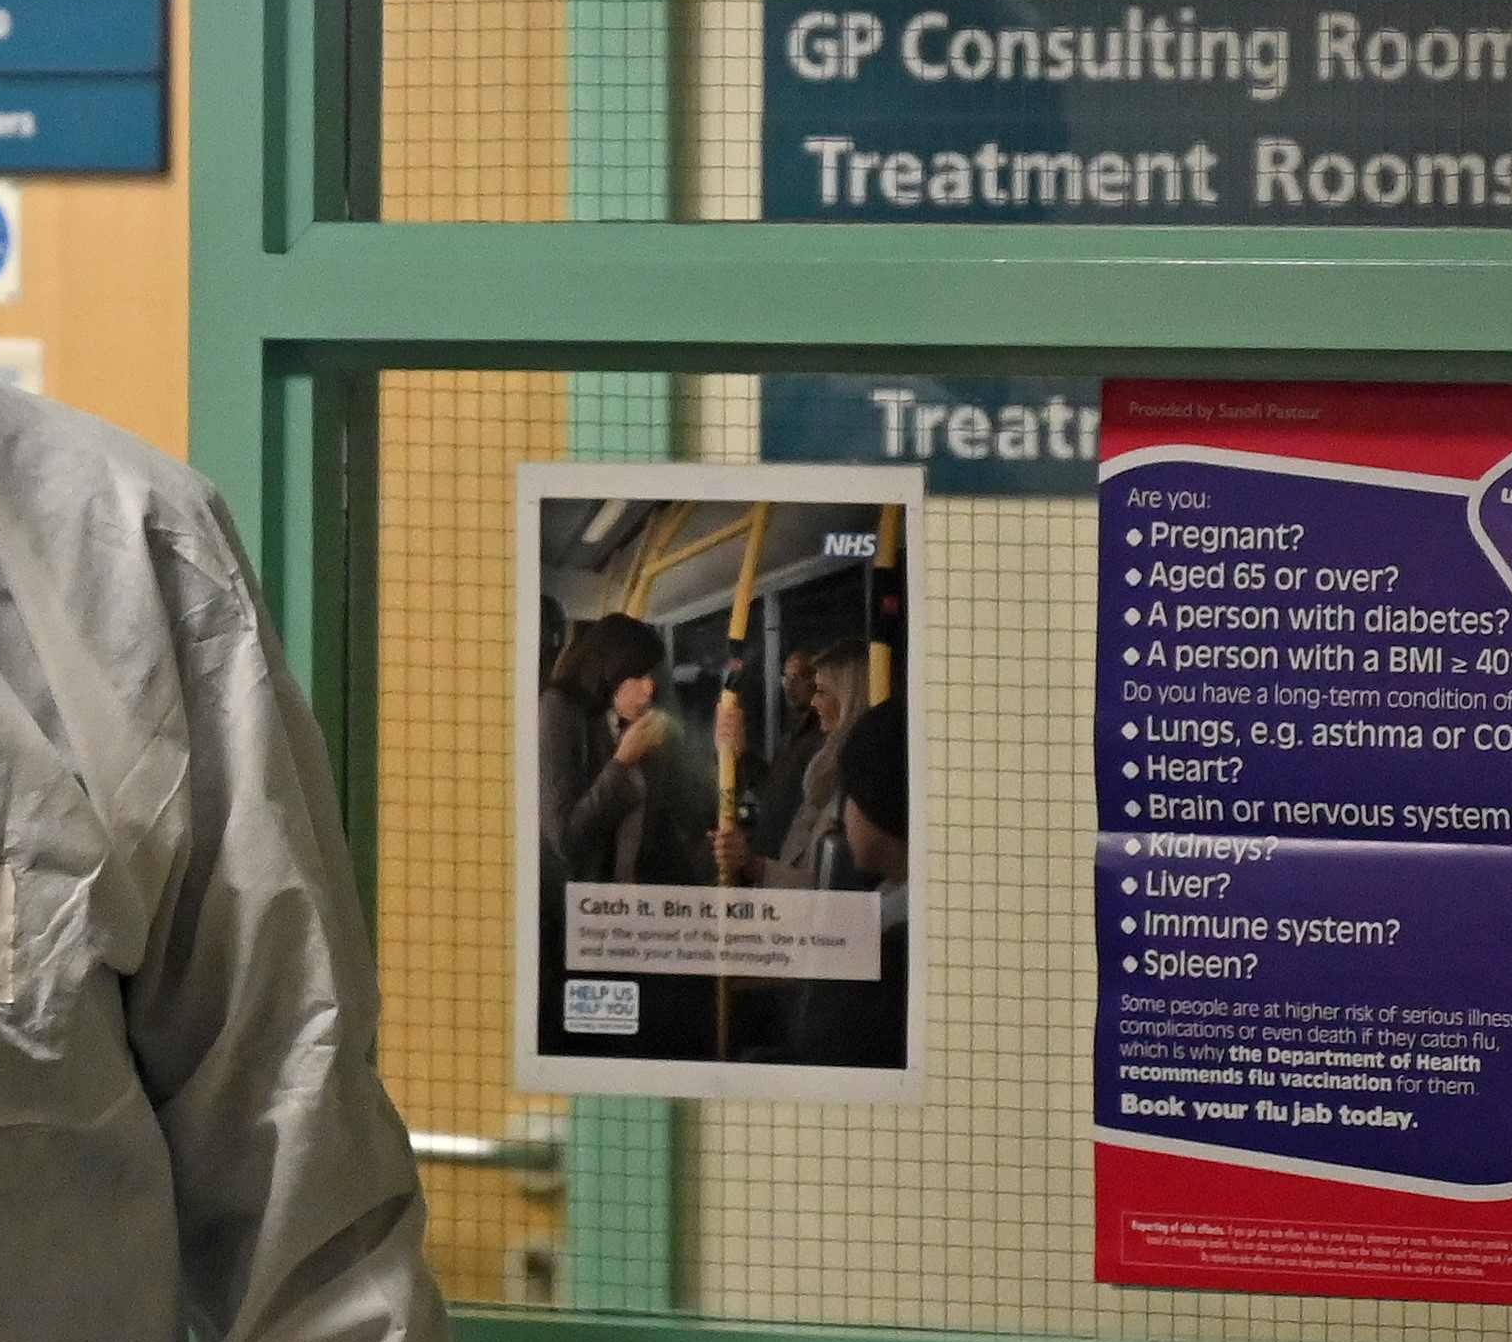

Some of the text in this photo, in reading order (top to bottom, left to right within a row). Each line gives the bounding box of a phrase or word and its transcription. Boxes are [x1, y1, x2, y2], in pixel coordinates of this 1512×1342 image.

[786, 12, 885, 82] GP
[902, 8, 1289, 98] Consulting
[805, 136, 1218, 208] Treatment
[1129, 402, 1192, 417] Provided
[1197, 403, 1214, 420] by
[1128, 488, 1212, 511] Are you:
[825, 534, 875, 556] NHS
[1150, 522, 1304, 552] Pregnant?
[1149, 561, 1399, 593] Aged 65 or over?
[1147, 601, 1509, 635] A person with diabetes?
[1146, 641, 1166, 667] A
[1175, 644, 1277, 671] person
[1287, 643, 1354, 671] with
[1363, 653, 1379, 672] a
[1390, 648, 1442, 673] BMI
[1124, 681, 1152, 702] Do
[1157, 687, 1196, 709] you
[1202, 683, 1251, 704] have
[1257, 689, 1268, 704] a
[1274, 683, 1378, 709] long-term
[1387, 687, 1487, 710] condition
[1146, 715, 1241, 748] Lungs,
[1250, 724, 1302, 750] e.g.
[1312, 720, 1423, 749] asthma
[1433, 728, 1463, 750] or
[1147, 757, 1244, 783] Heart?
[1148, 793, 1224, 822] Brain
[1232, 802, 1261, 823] or
[1273, 803, 1394, 826] nervous
[1150, 832, 1279, 864] Kidneys?
[1145, 870, 1231, 899] Liver?
[579, 898, 629, 917] Catch
[637, 900, 655, 917] it.
[664, 901, 691, 918] Bin
[700, 901, 717, 919] it.
[726, 902, 754, 920] Kill
[1144, 910, 1401, 947] Immune system?
[1144, 949, 1258, 981] Spleen?
[1120, 993, 1166, 1014] Some
[1170, 998, 1228, 1017] people
[1232, 1002, 1259, 1017] are
[1263, 1001, 1279, 1018] at
[1284, 1001, 1340, 1024] higher
[1344, 1003, 1374, 1022] risk
[1378, 1004, 1398, 1023] of
[1401, 1007, 1463, 1026] serious
[1119, 1018, 1500, 1051] complications or even death if they catch flu,
[1119, 1040, 1481, 1073] which is why the Department of Health
[1119, 1063, 1243, 1085] recommends
[1248, 1066, 1275, 1087] flu
[1280, 1070, 1392, 1092] vaccination
[1396, 1075, 1422, 1094] for
[1120, 1093, 1418, 1131] Book your flu jab today.
